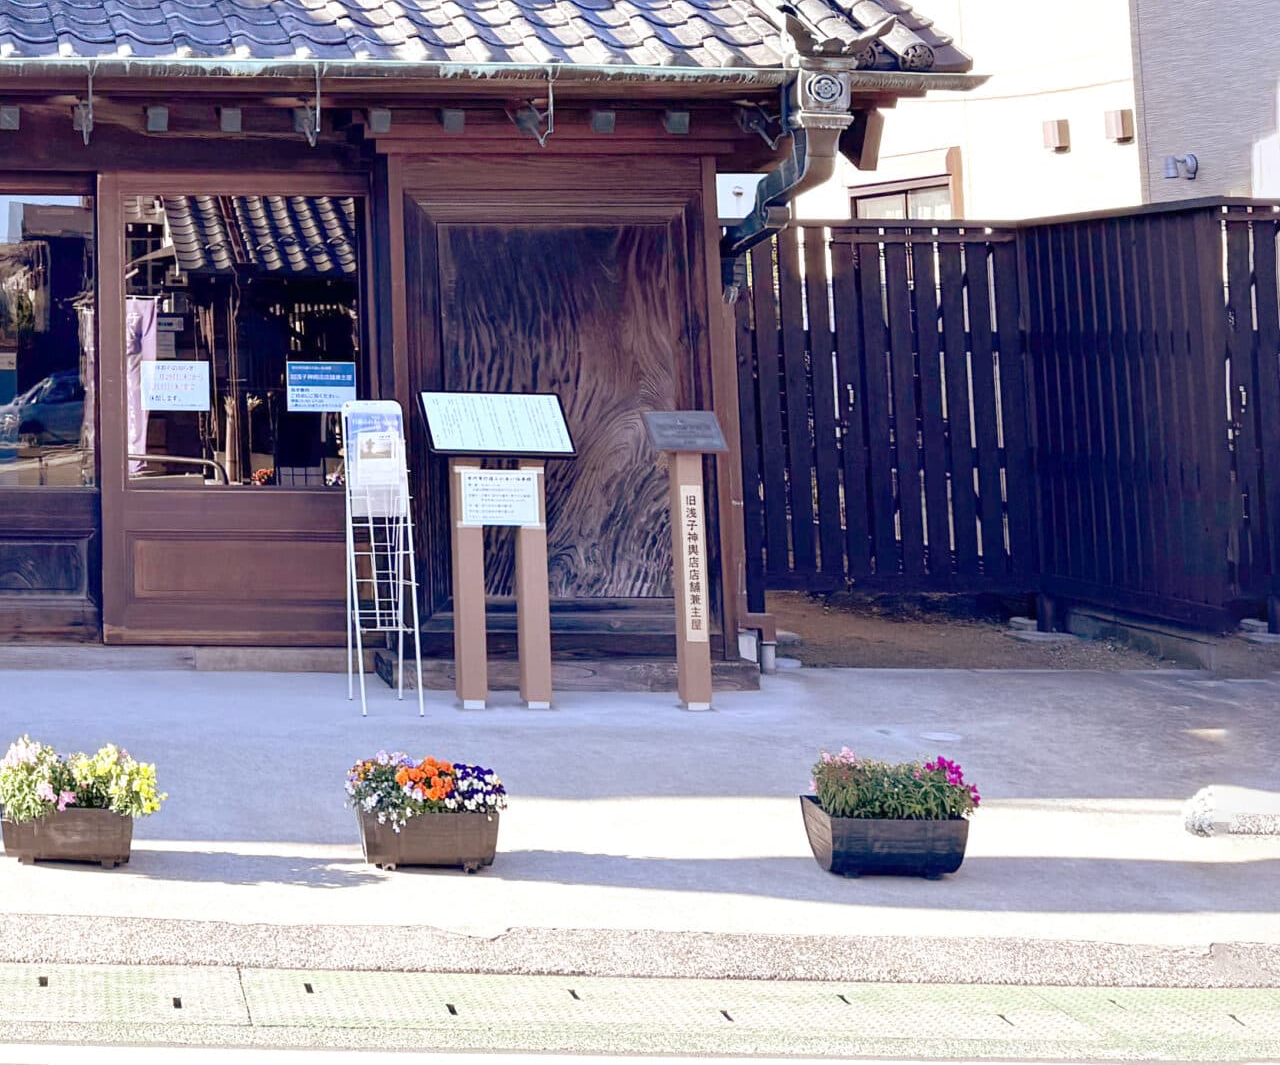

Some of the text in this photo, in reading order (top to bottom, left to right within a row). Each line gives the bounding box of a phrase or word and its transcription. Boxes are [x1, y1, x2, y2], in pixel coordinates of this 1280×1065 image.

[685, 494, 702, 631] 旧浅子神輿店店舗兼主屋
